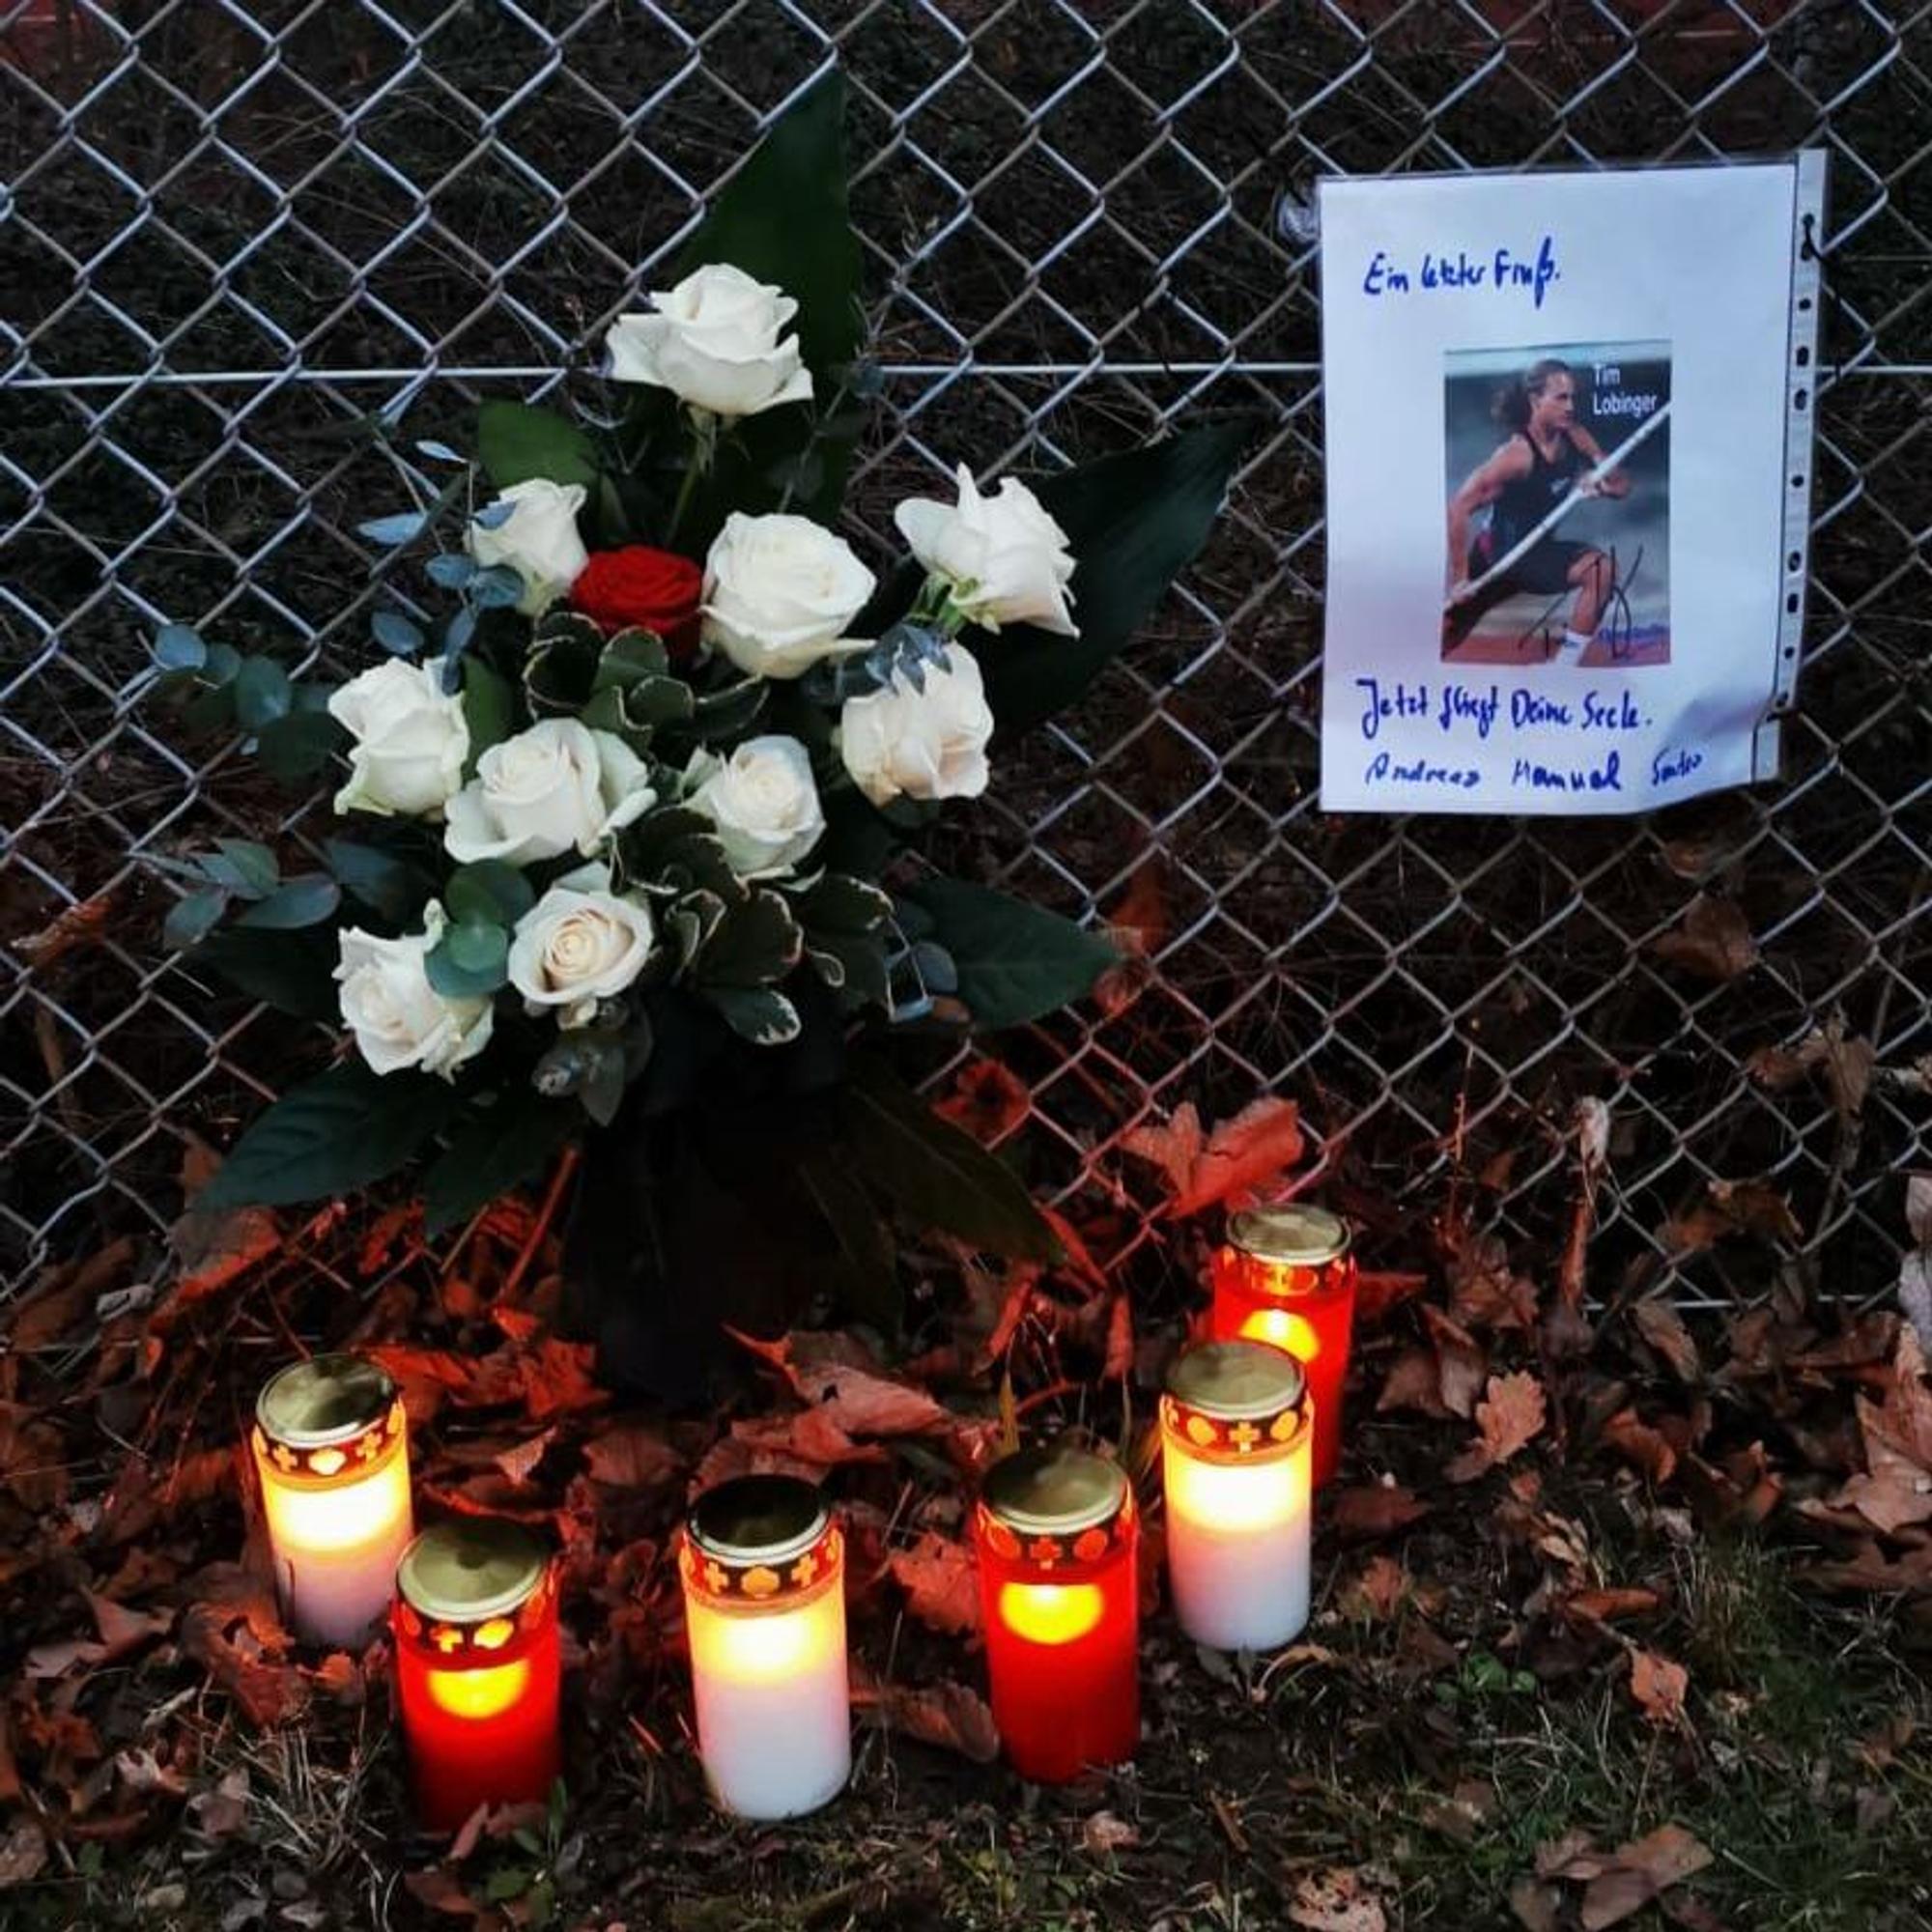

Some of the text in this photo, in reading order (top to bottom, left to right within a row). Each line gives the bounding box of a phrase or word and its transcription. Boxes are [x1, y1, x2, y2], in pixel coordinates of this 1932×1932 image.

[1363, 252, 1409, 295] Ein
[1593, 363, 1621, 386] Tim
[1593, 390, 1658, 418] Lobinger
[1355, 678, 1653, 740] Jetzt fliegt Deine Seele.
